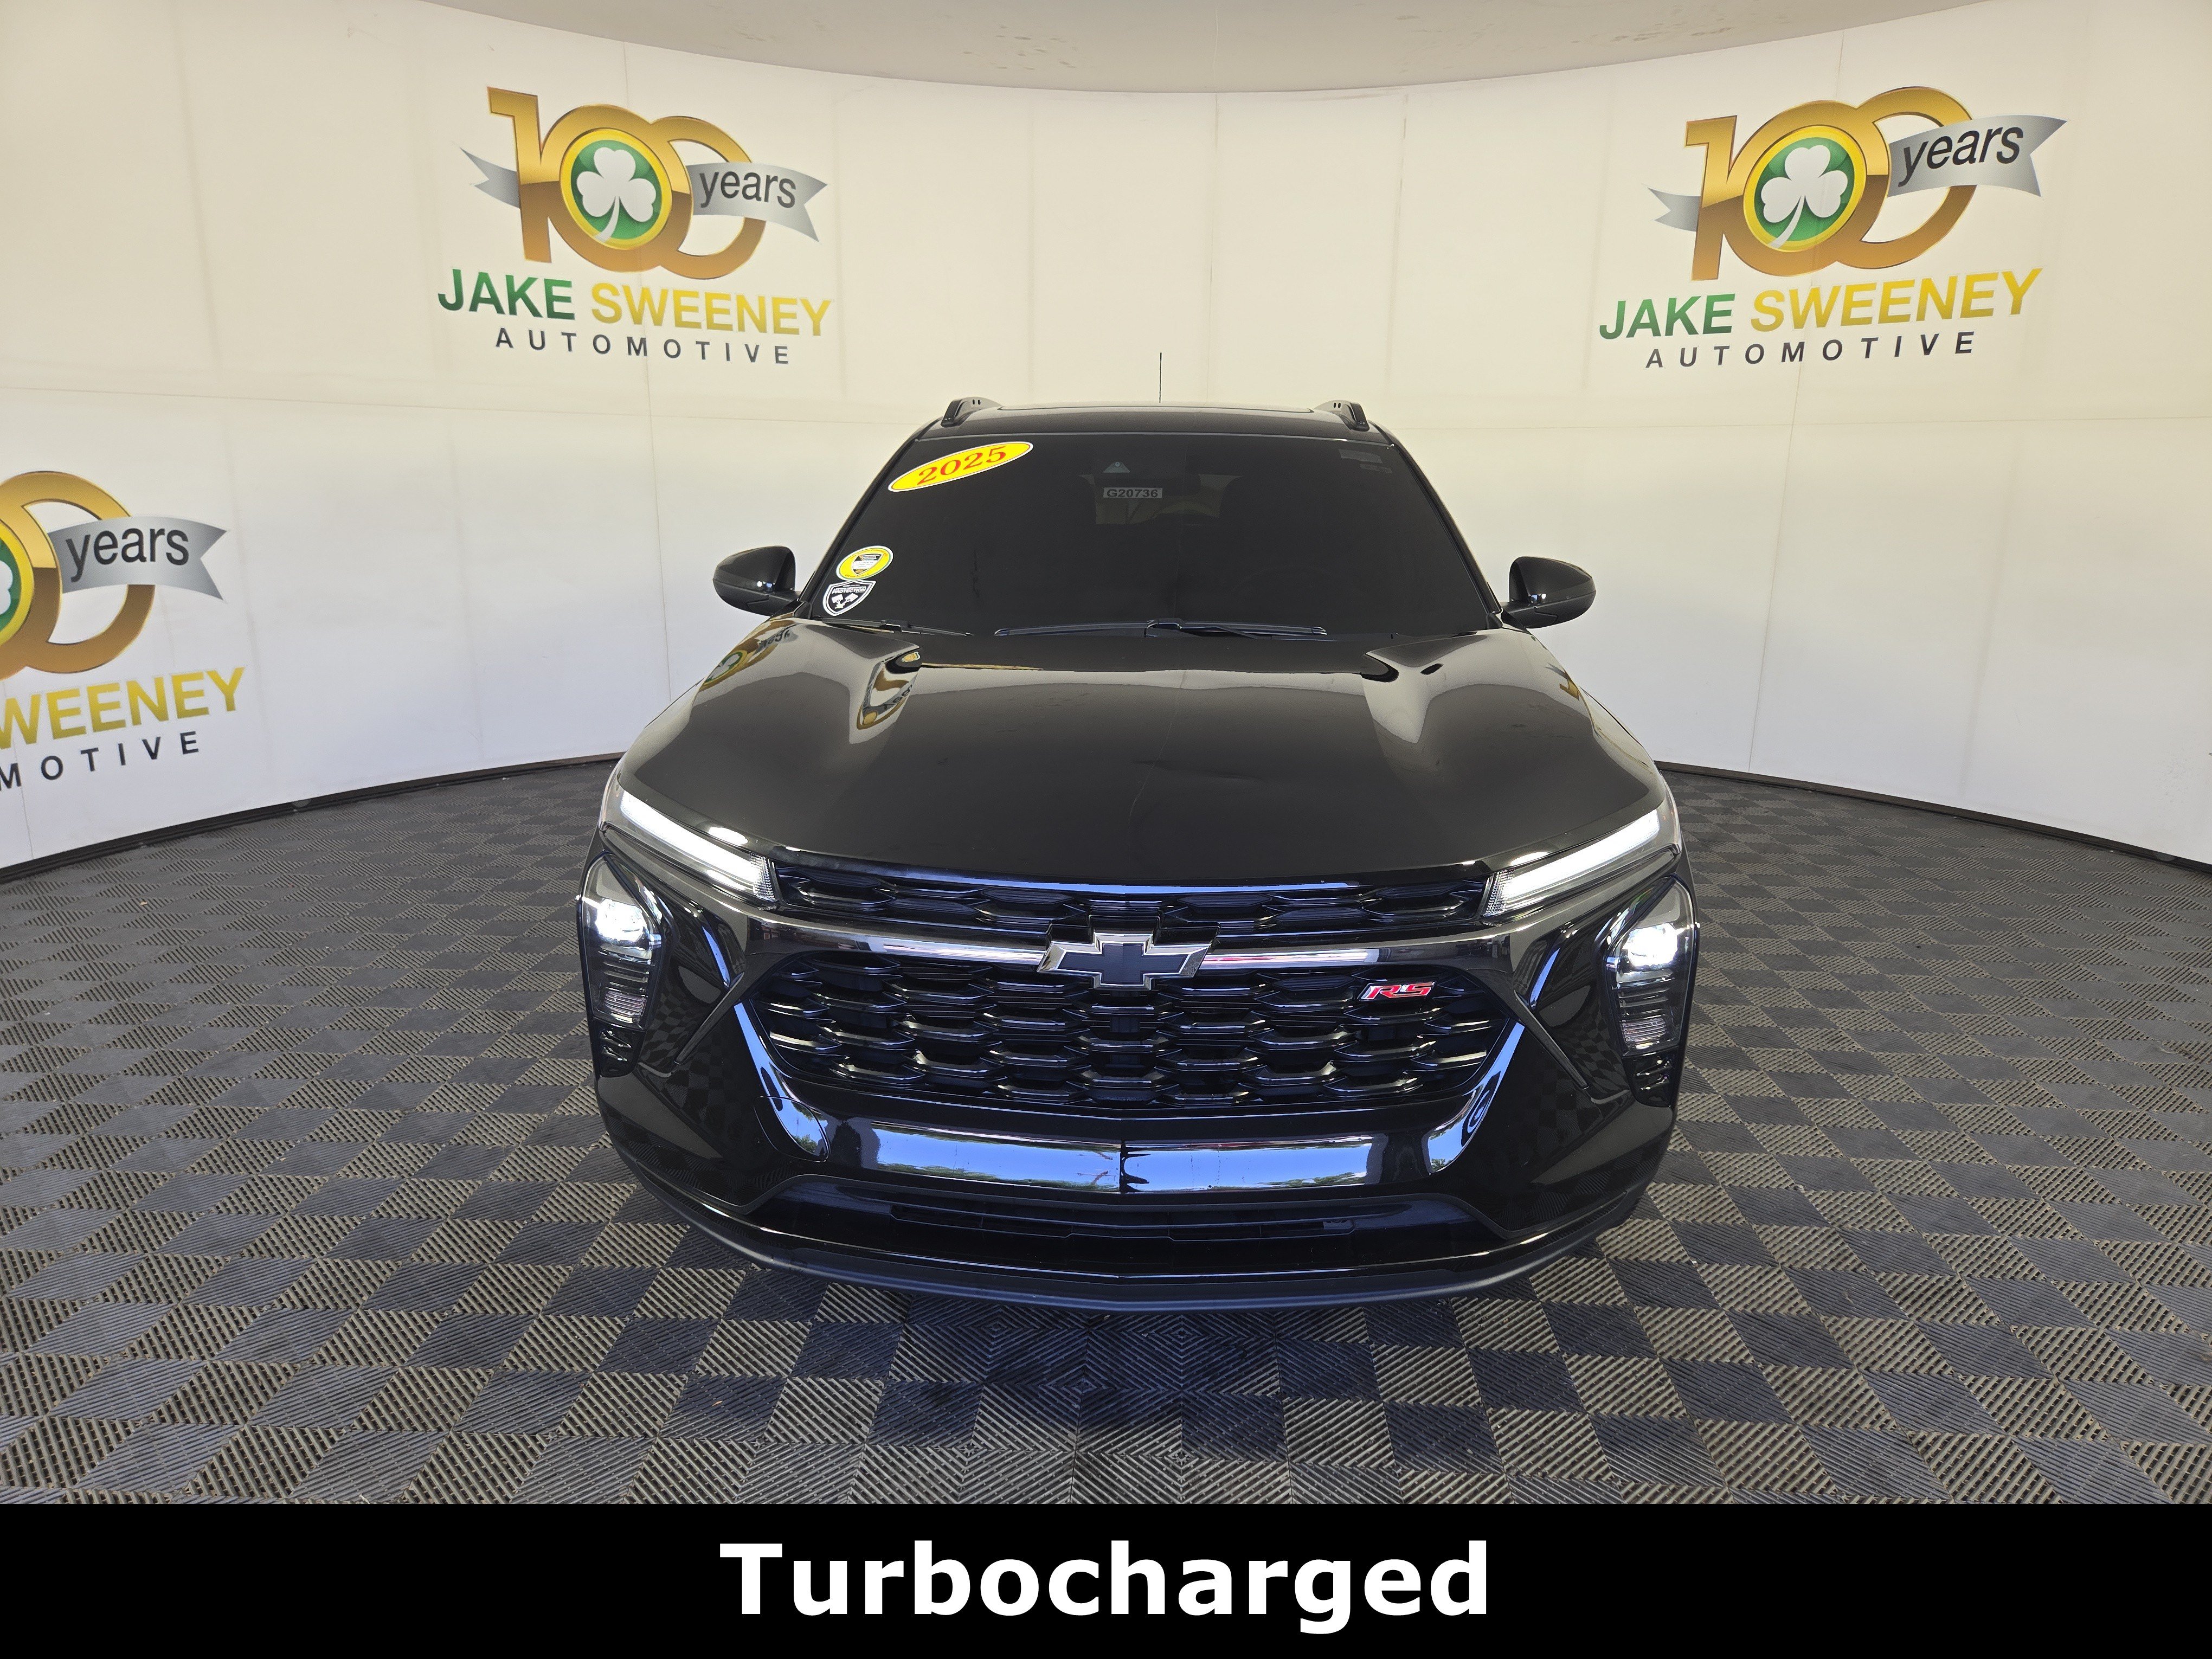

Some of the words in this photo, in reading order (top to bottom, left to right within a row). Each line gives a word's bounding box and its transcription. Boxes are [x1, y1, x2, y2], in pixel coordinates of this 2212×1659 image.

[1898, 124, 2024, 188] years
[699, 169, 797, 209] years
[438, 268, 575, 320] JAKE
[591, 282, 832, 337] SWEENEY
[1599, 293, 1735, 340] JAKE
[1751, 268, 2043, 333] SWEENEY
[496, 327, 789, 365] AUTOMOTIVE
[1645, 331, 1975, 369] AUTOMOTIVE
[917, 445, 1006, 486] 2025
[1107, 488, 1158, 498] G20736
[66, 527, 190, 583] years
[1360, 982, 1435, 1000] RS
